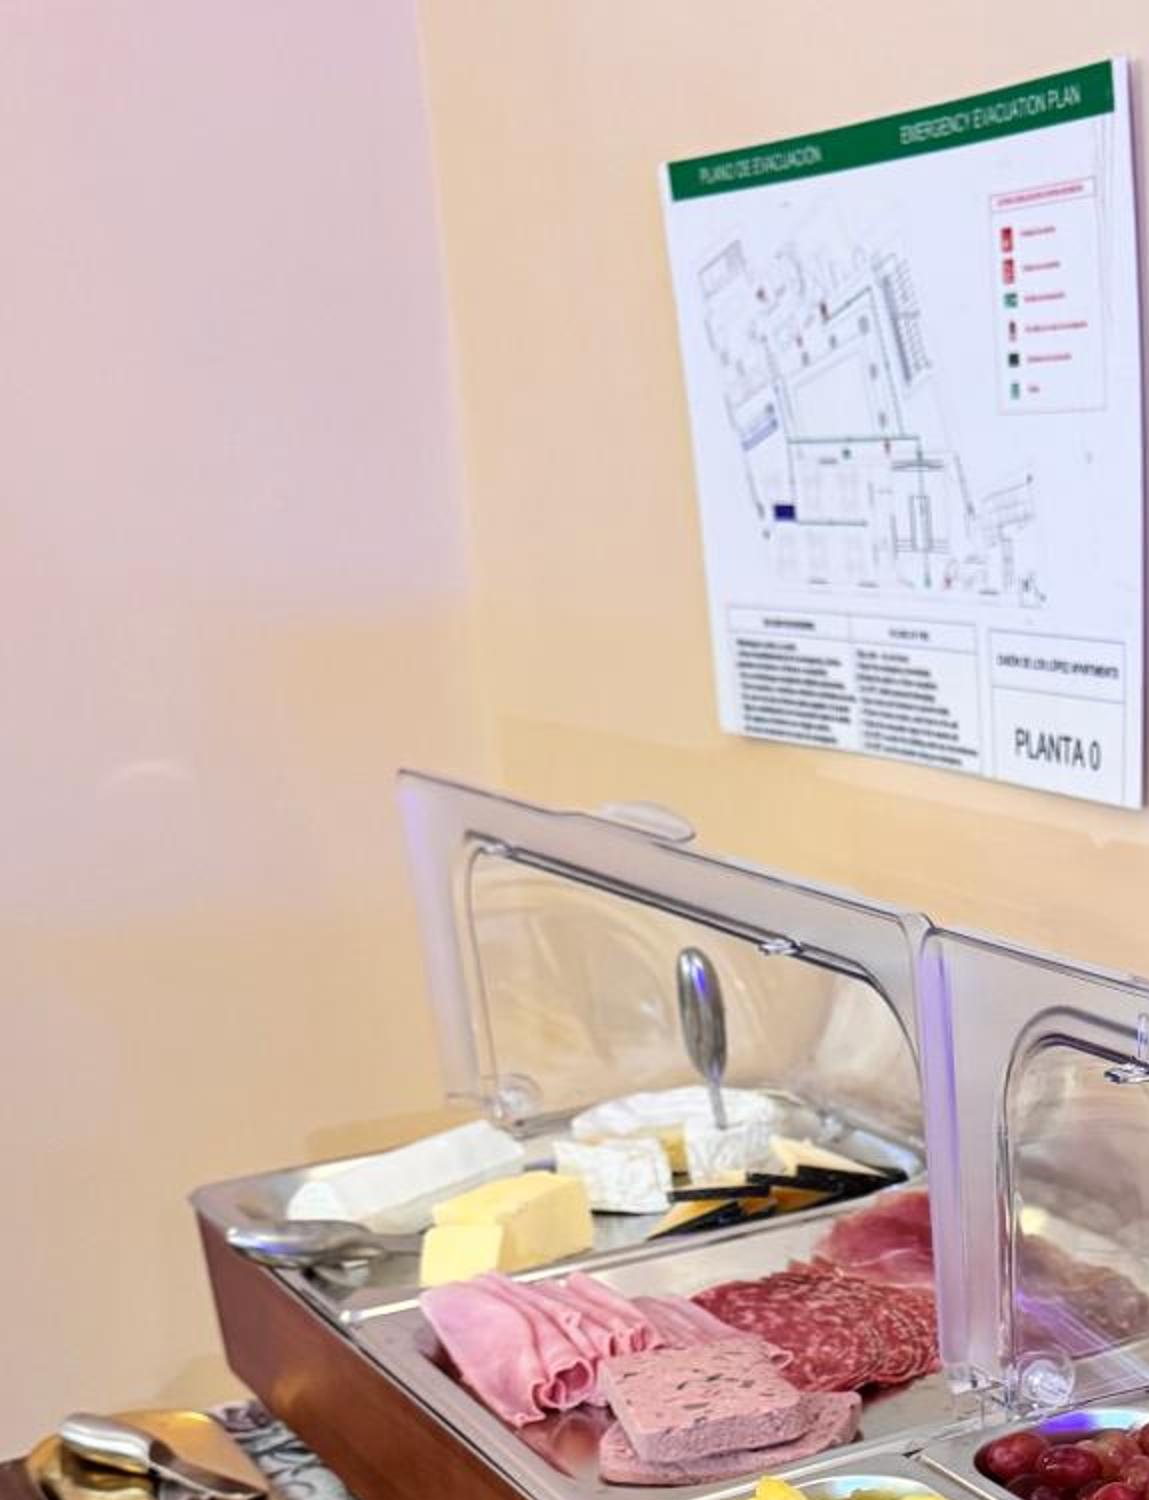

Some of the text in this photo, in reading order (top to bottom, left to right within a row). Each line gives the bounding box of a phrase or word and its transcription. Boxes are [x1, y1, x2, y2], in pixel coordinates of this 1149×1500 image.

[1047, 84, 1082, 110] PLAN
[1015, 728, 1086, 769] PLANTA
[1089, 740, 1102, 772] 0
